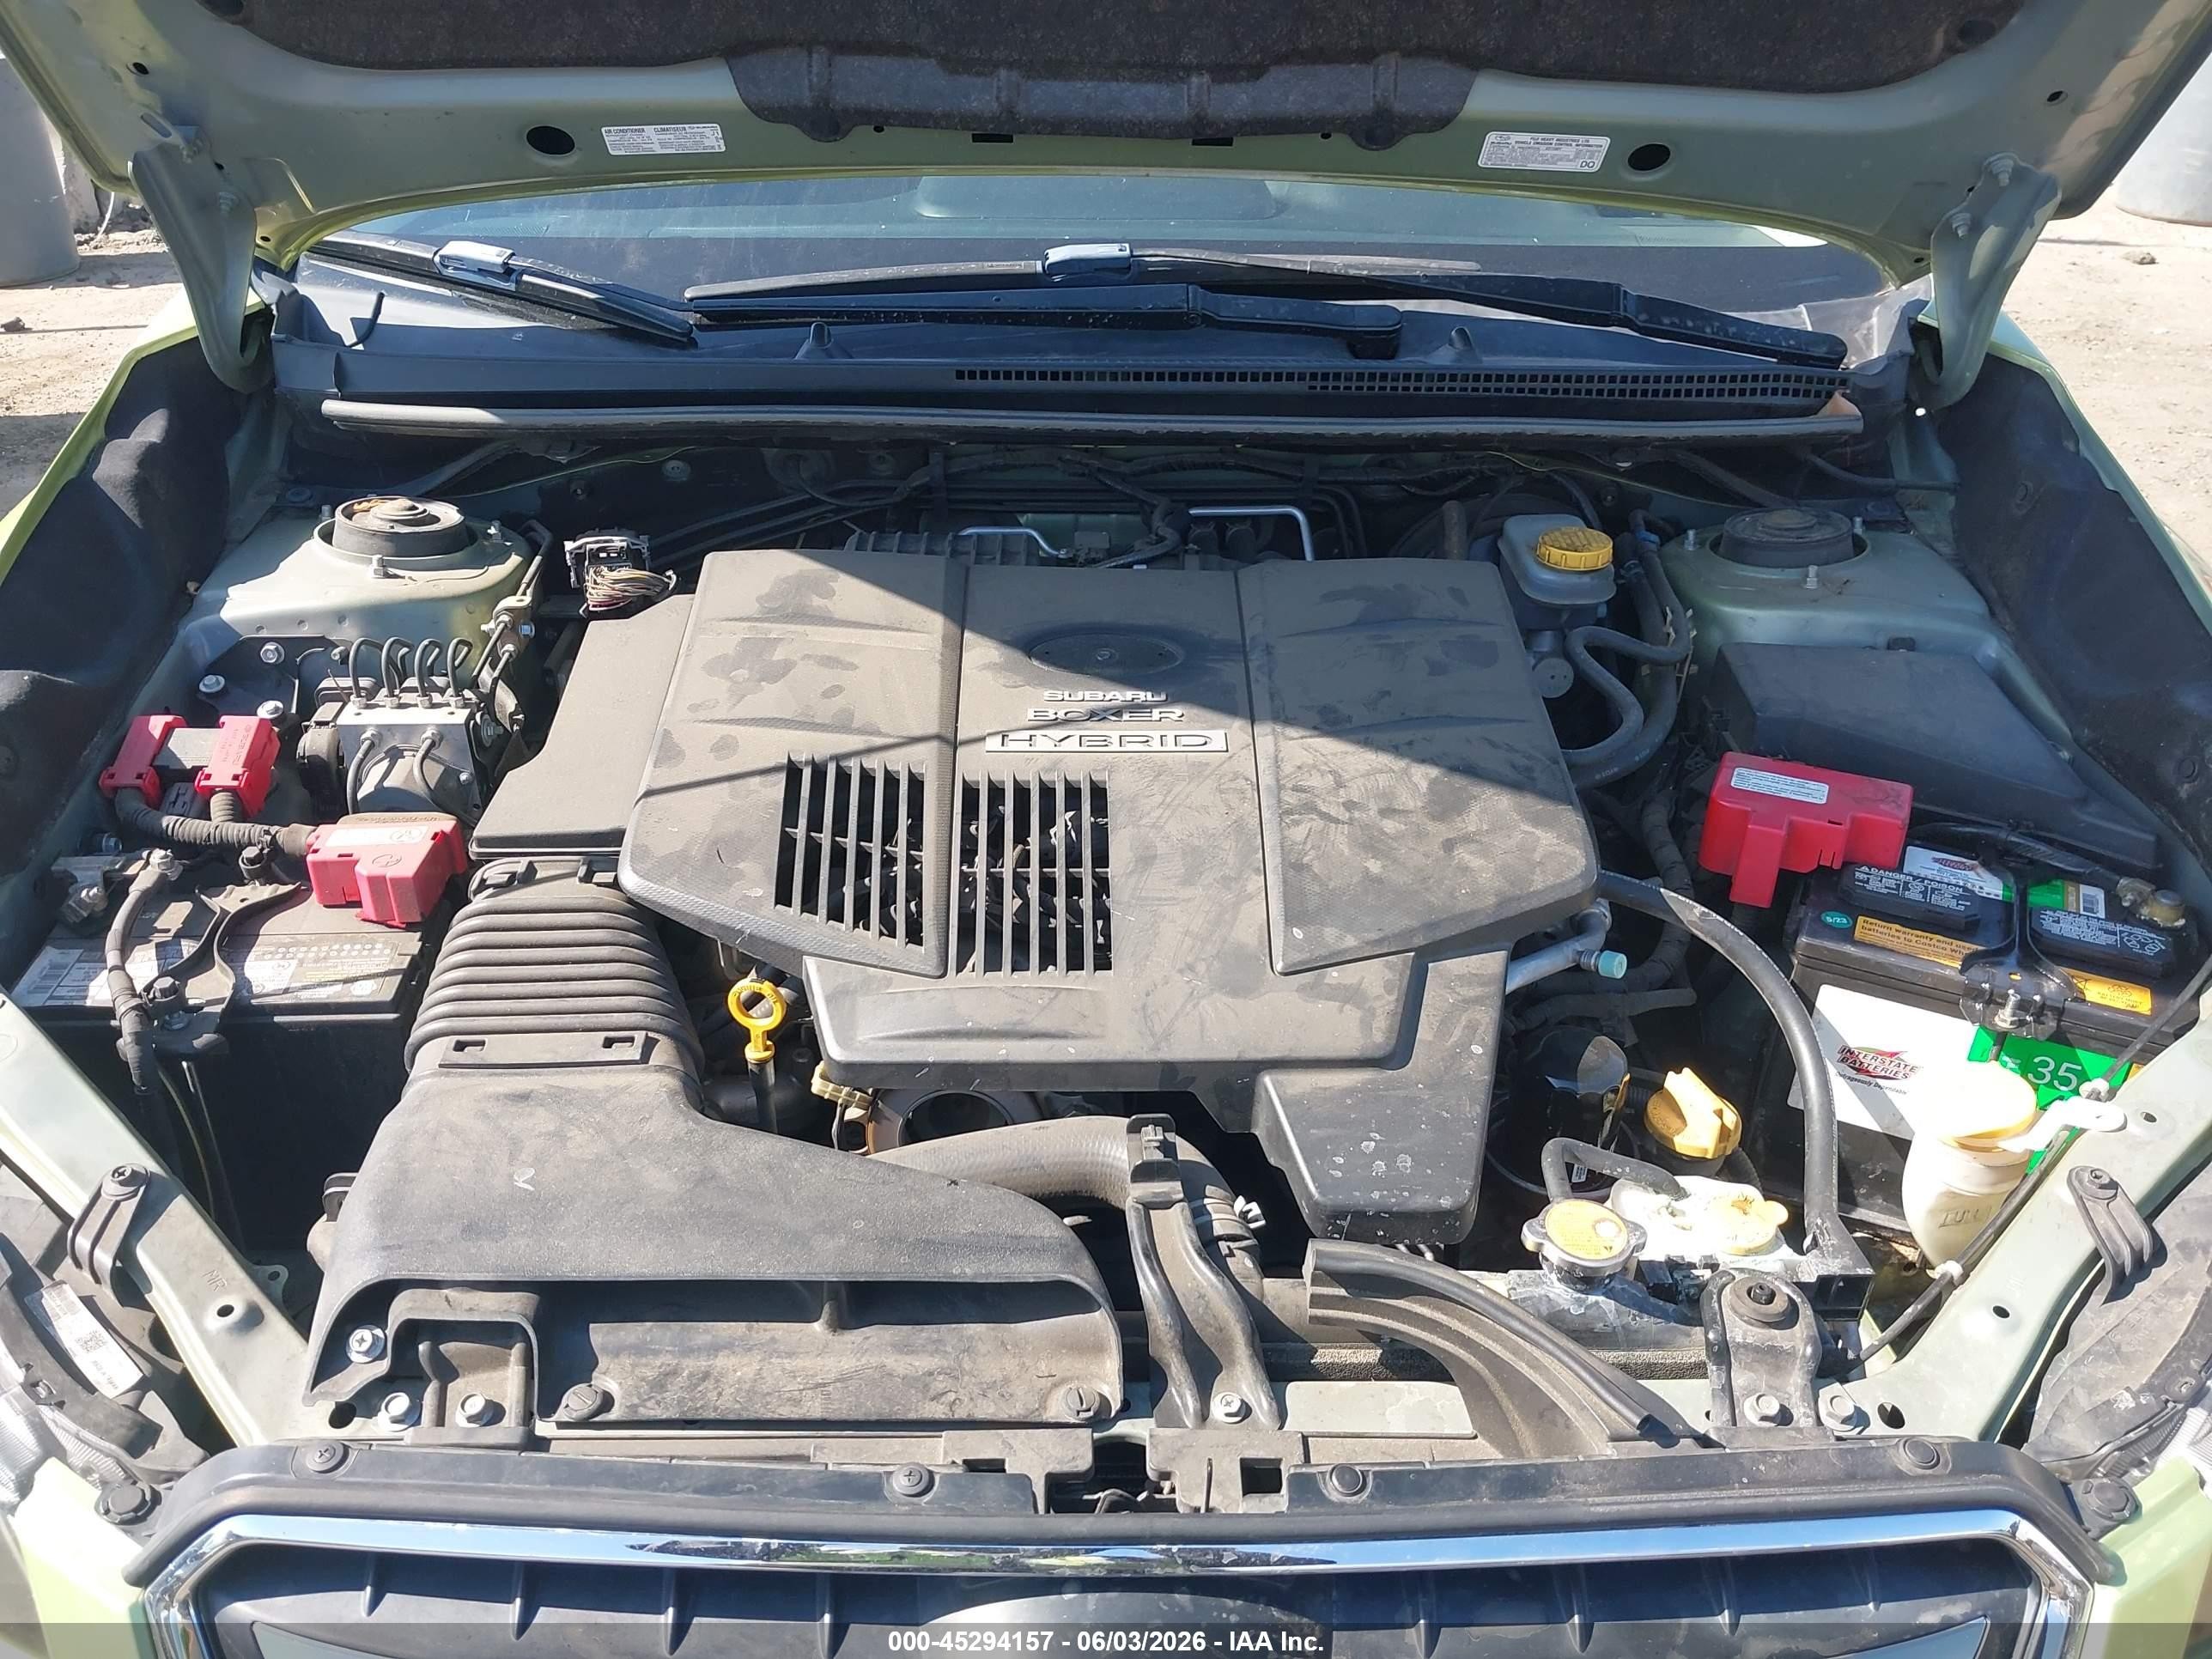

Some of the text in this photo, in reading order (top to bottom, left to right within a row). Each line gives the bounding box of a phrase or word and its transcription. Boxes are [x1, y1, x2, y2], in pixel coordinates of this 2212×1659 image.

[1043, 690, 1169, 702] SUBARU
[1028, 708, 1185, 722] BOXER
[1000, 733, 1213, 748] HYBRID
[1870, 867, 1913, 882] DANGER
[1923, 880, 1964, 894] POISON
[1861, 925, 1901, 940] batteries
[1915, 939, 1948, 952] Costco
[1862, 919, 1893, 932] Return
[1894, 928, 1934, 943] warranty
[1936, 937, 1954, 947] and
[1840, 1047, 1919, 1073] INTERSTATE
[1840, 1056, 1911, 1079] BATTERIES
[2027, 1056, 2082, 1091] 35
